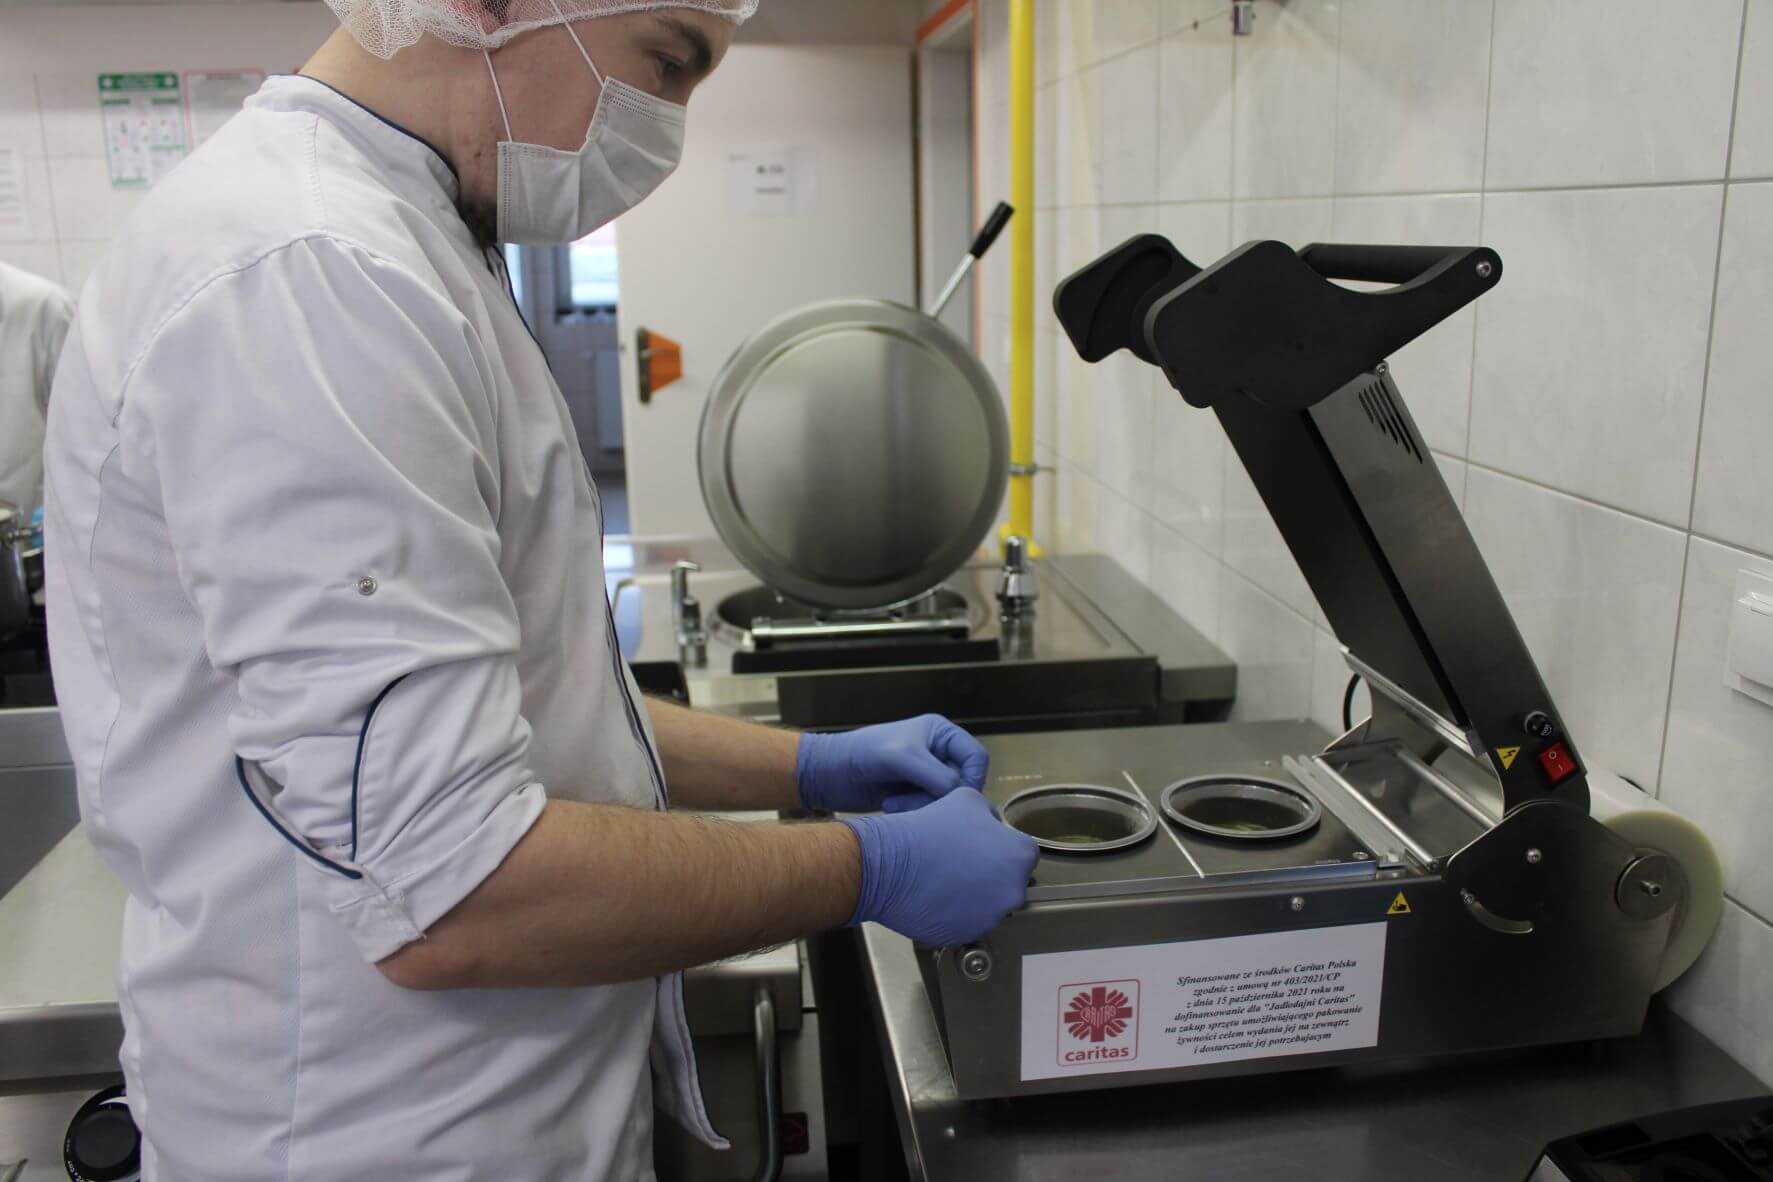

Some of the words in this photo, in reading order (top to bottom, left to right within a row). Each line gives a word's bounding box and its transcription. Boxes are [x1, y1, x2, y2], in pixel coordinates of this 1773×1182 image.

[1177, 974, 1241, 986] Sfinansowane
[1254, 967, 1291, 977] środków
[1294, 964, 1324, 973] Caritas
[1328, 960, 1357, 969] Polska
[1193, 985, 1228, 997] zgodnie
[1237, 982, 1269, 990] umową
[1284, 972, 1341, 985] 403/2021/CP
[1193, 999, 1214, 1007] dnia
[1216, 997, 1227, 1005] 15
[1229, 991, 1284, 1005] października
[1287, 988, 1308, 997] 2021
[1311, 985, 1331, 994] roku
[1174, 1007, 1245, 1021] dofinansowanie
[1247, 1005, 1261, 1013] dla
[1179, 1023, 1205, 1032] zakup
[1208, 1020, 1239, 1030] sprzętu
[1241, 1012, 1314, 1024] umożliwiającego
[1315, 1005, 1363, 1019] pakowanie
[1177, 1033, 1217, 1046] żywności
[1219, 1031, 1244, 1039] celem
[1247, 1025, 1283, 1037] wydania
[1284, 1023, 1296, 1034] jej
[1311, 1019, 1349, 1029] zewnątrz
[1065, 1046, 1129, 1062] caritas
[1199, 1040, 1254, 1053] dostarczenie
[1254, 1039, 1267, 1048] jej
